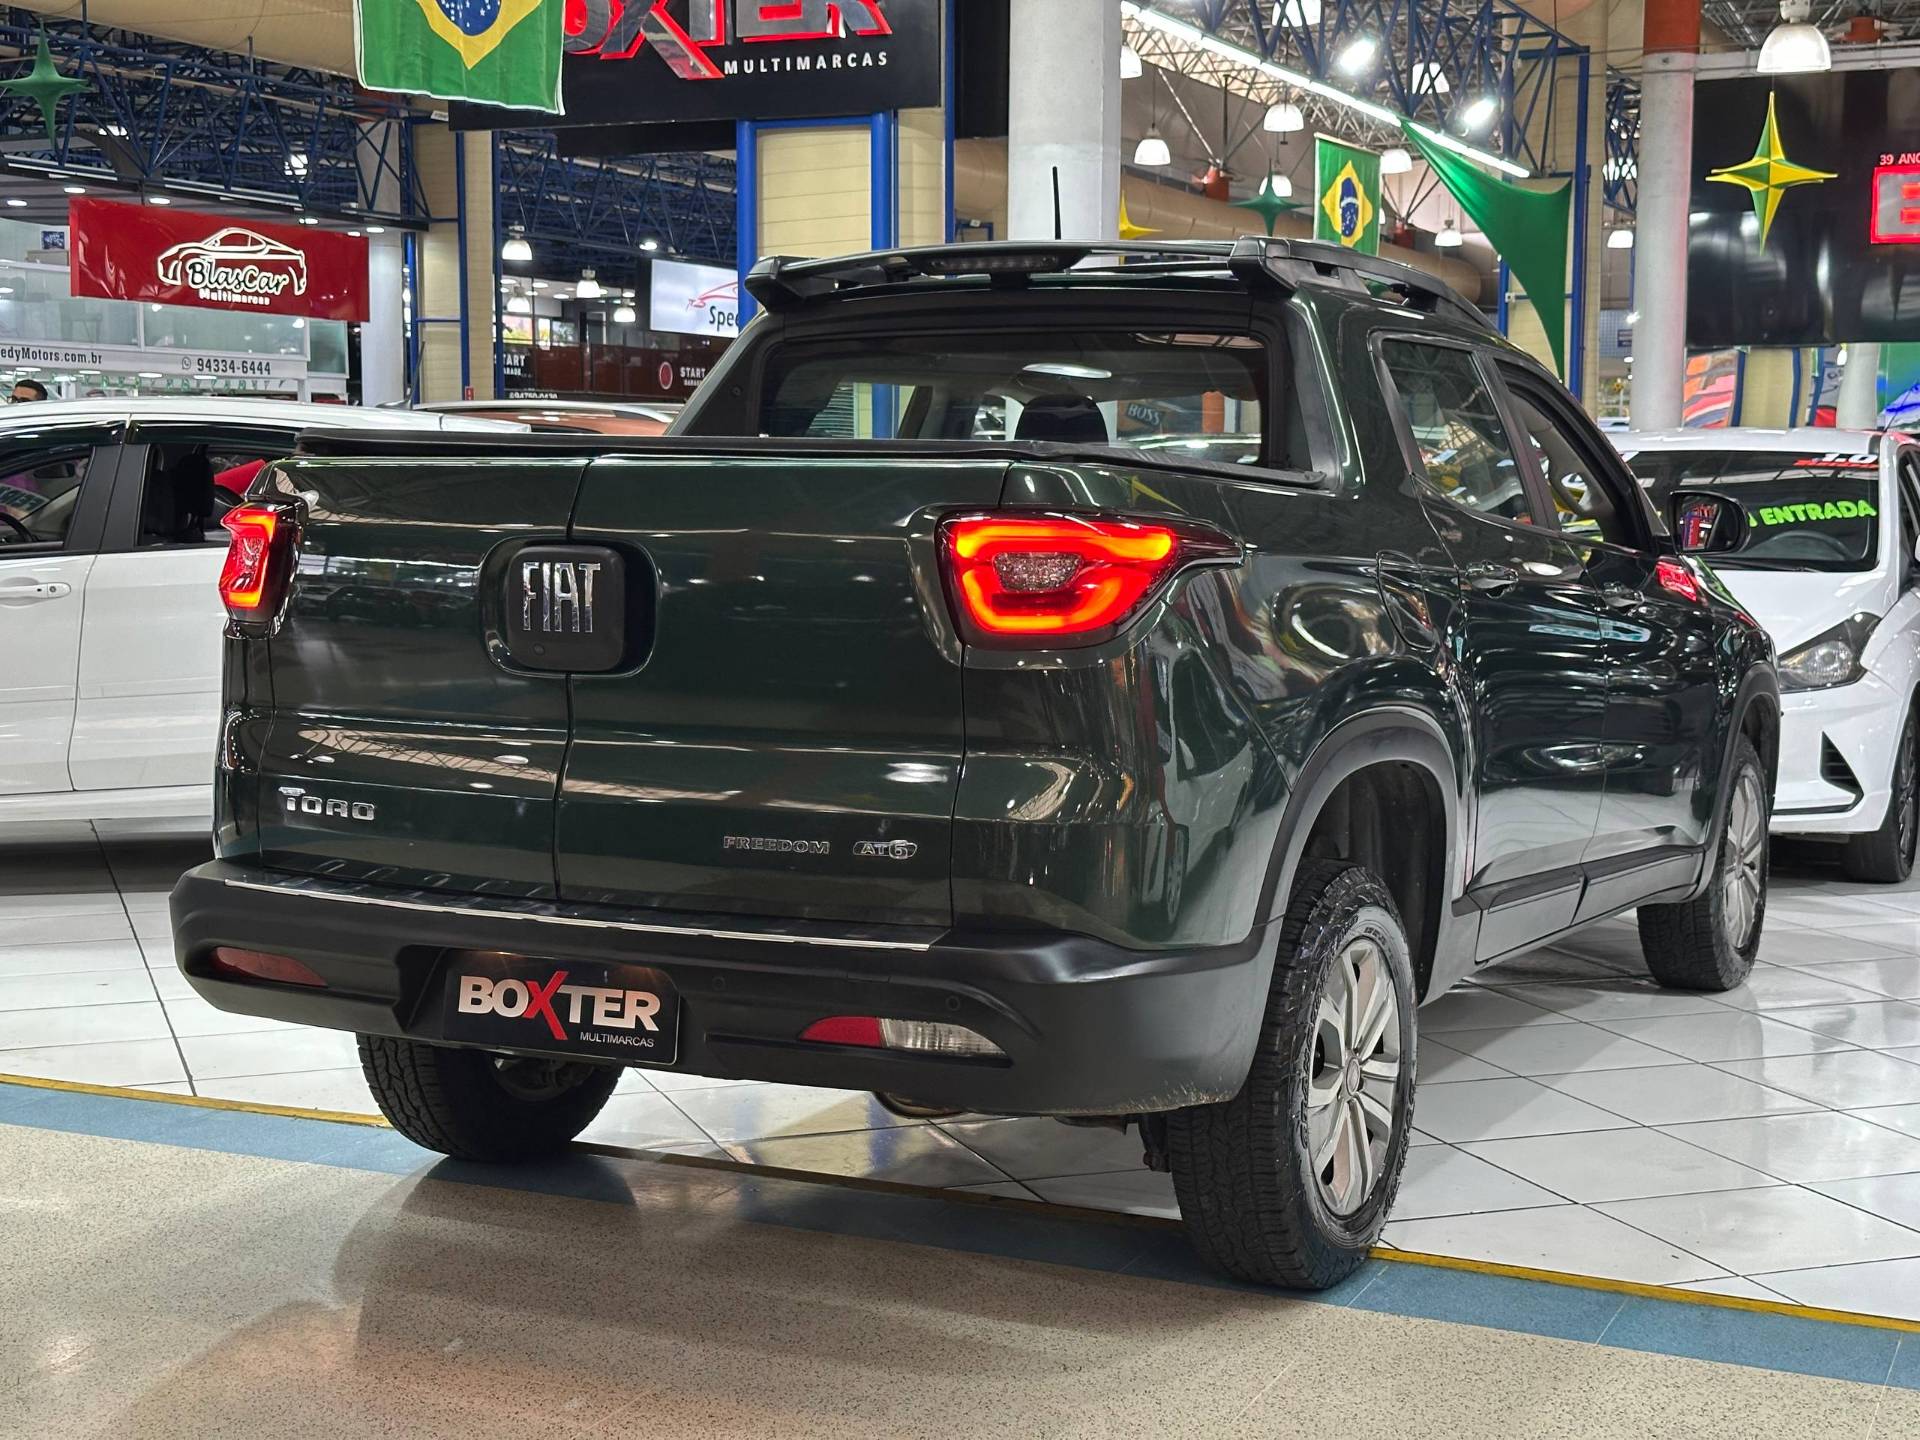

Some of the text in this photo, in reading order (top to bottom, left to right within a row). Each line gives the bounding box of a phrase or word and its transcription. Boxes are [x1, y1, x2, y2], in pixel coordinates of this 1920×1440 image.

[724, 52, 888, 75] MULTIMARCAS
[1880, 154, 1894, 165] 39
[186, 257, 289, 295] BlasCar
[197, 358, 271, 375] 94334-6444
[680, 366, 705, 379] START
[1759, 500, 1877, 526] ENTRADA
[523, 562, 601, 633] FIAT
[278, 787, 375, 821] TORO
[723, 836, 910, 860] FREEDOM AT6
[458, 970, 660, 1041] BOXTER
[579, 1031, 655, 1048] MULTIMARCAS
